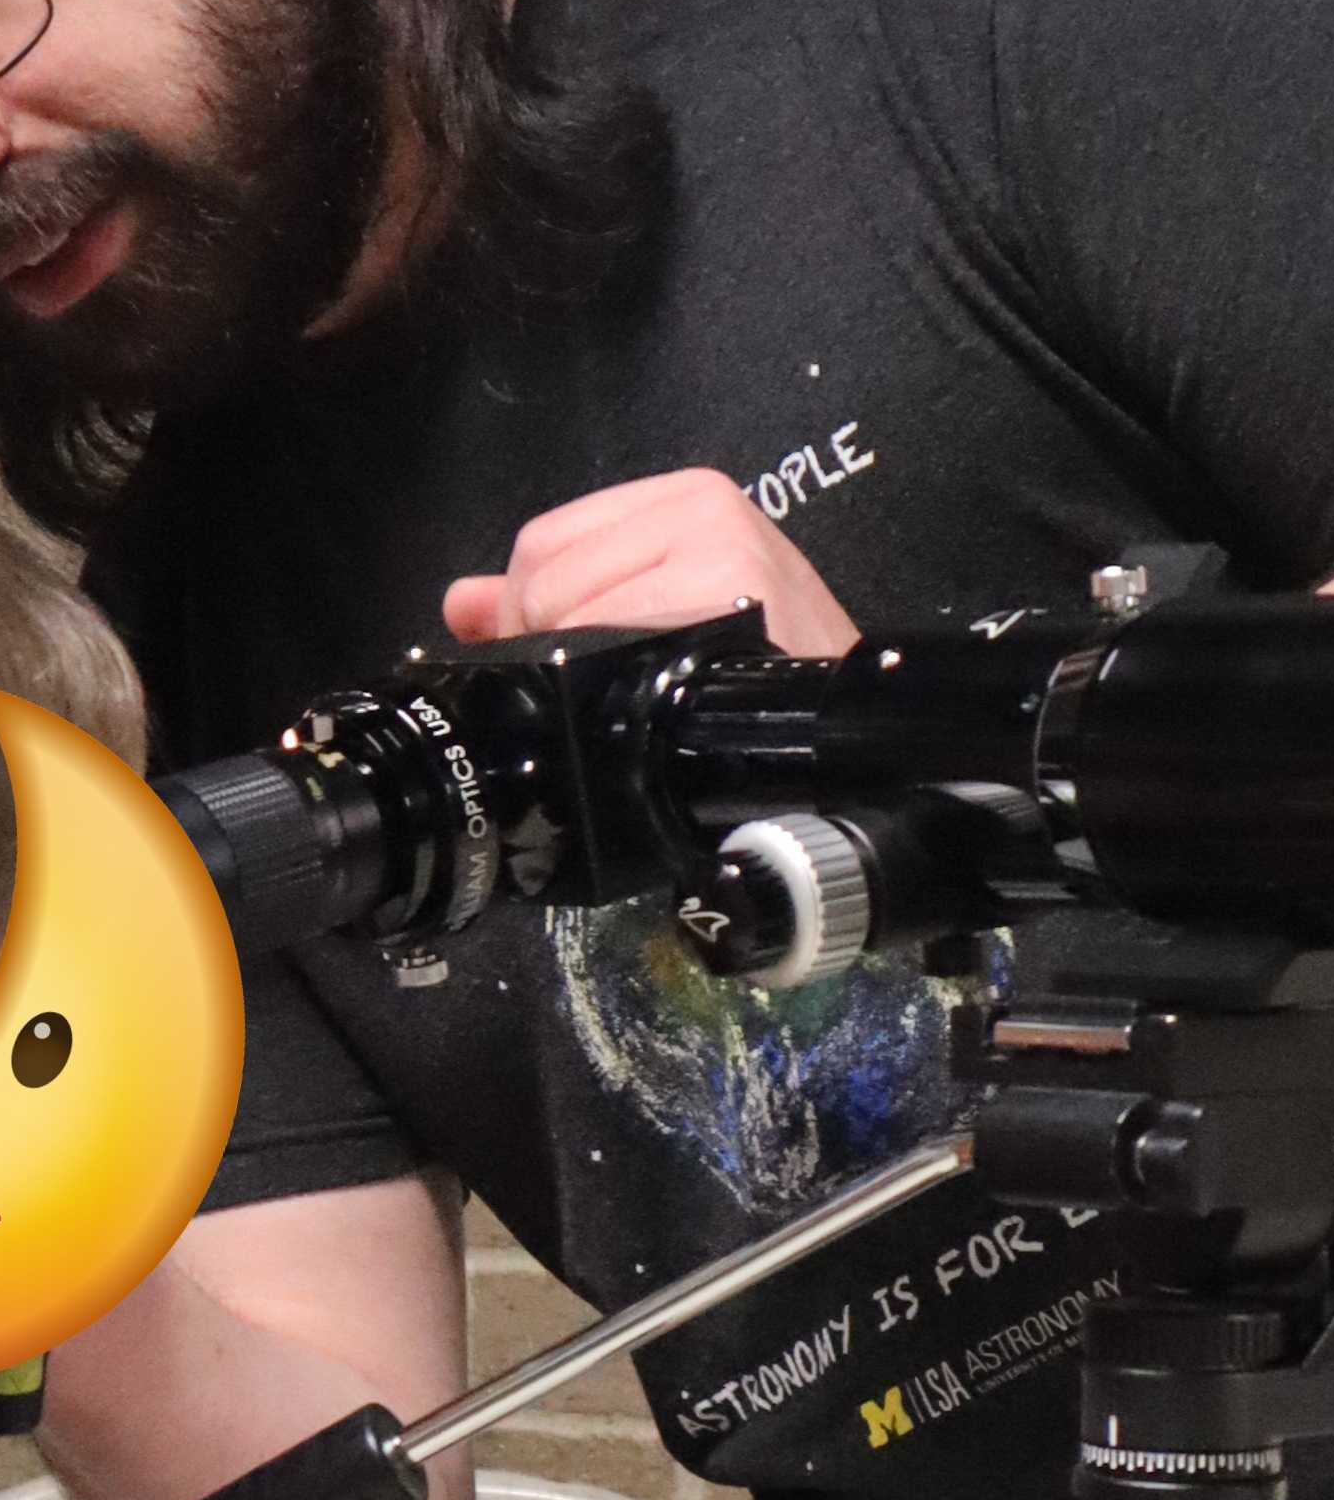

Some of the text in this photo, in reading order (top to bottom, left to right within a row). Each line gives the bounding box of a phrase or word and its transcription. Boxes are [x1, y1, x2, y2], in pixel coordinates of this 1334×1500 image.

[742, 420, 875, 520] OPLE
[409, 695, 452, 738] USA
[443, 744, 488, 840] OPTICS
[676, 1213, 1045, 1440] ASTRONOMY IS FOR
[916, 1360, 972, 1420] LSA
